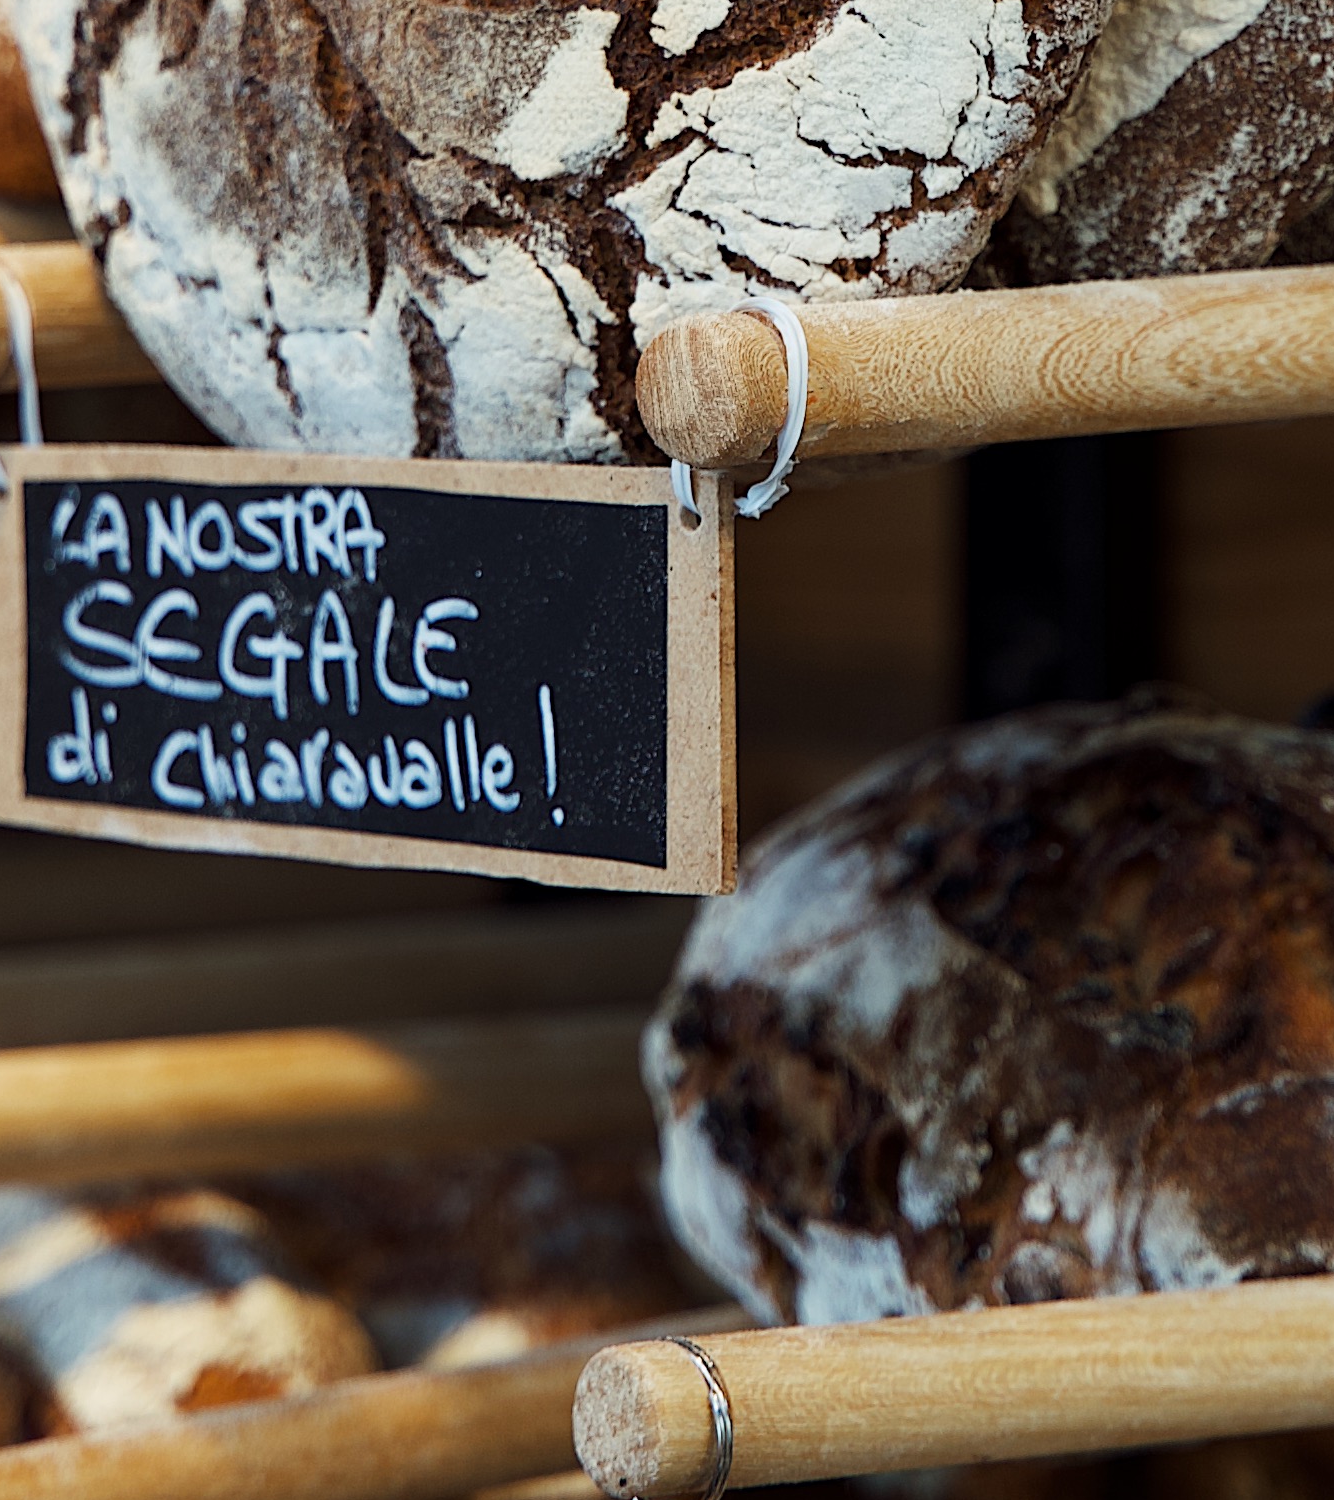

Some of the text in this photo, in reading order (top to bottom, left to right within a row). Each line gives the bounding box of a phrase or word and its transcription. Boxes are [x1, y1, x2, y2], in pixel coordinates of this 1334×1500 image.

[51, 486, 385, 582] LA NOSTRA
[62, 581, 479, 719] SEGALE
[47, 687, 117, 784] di
